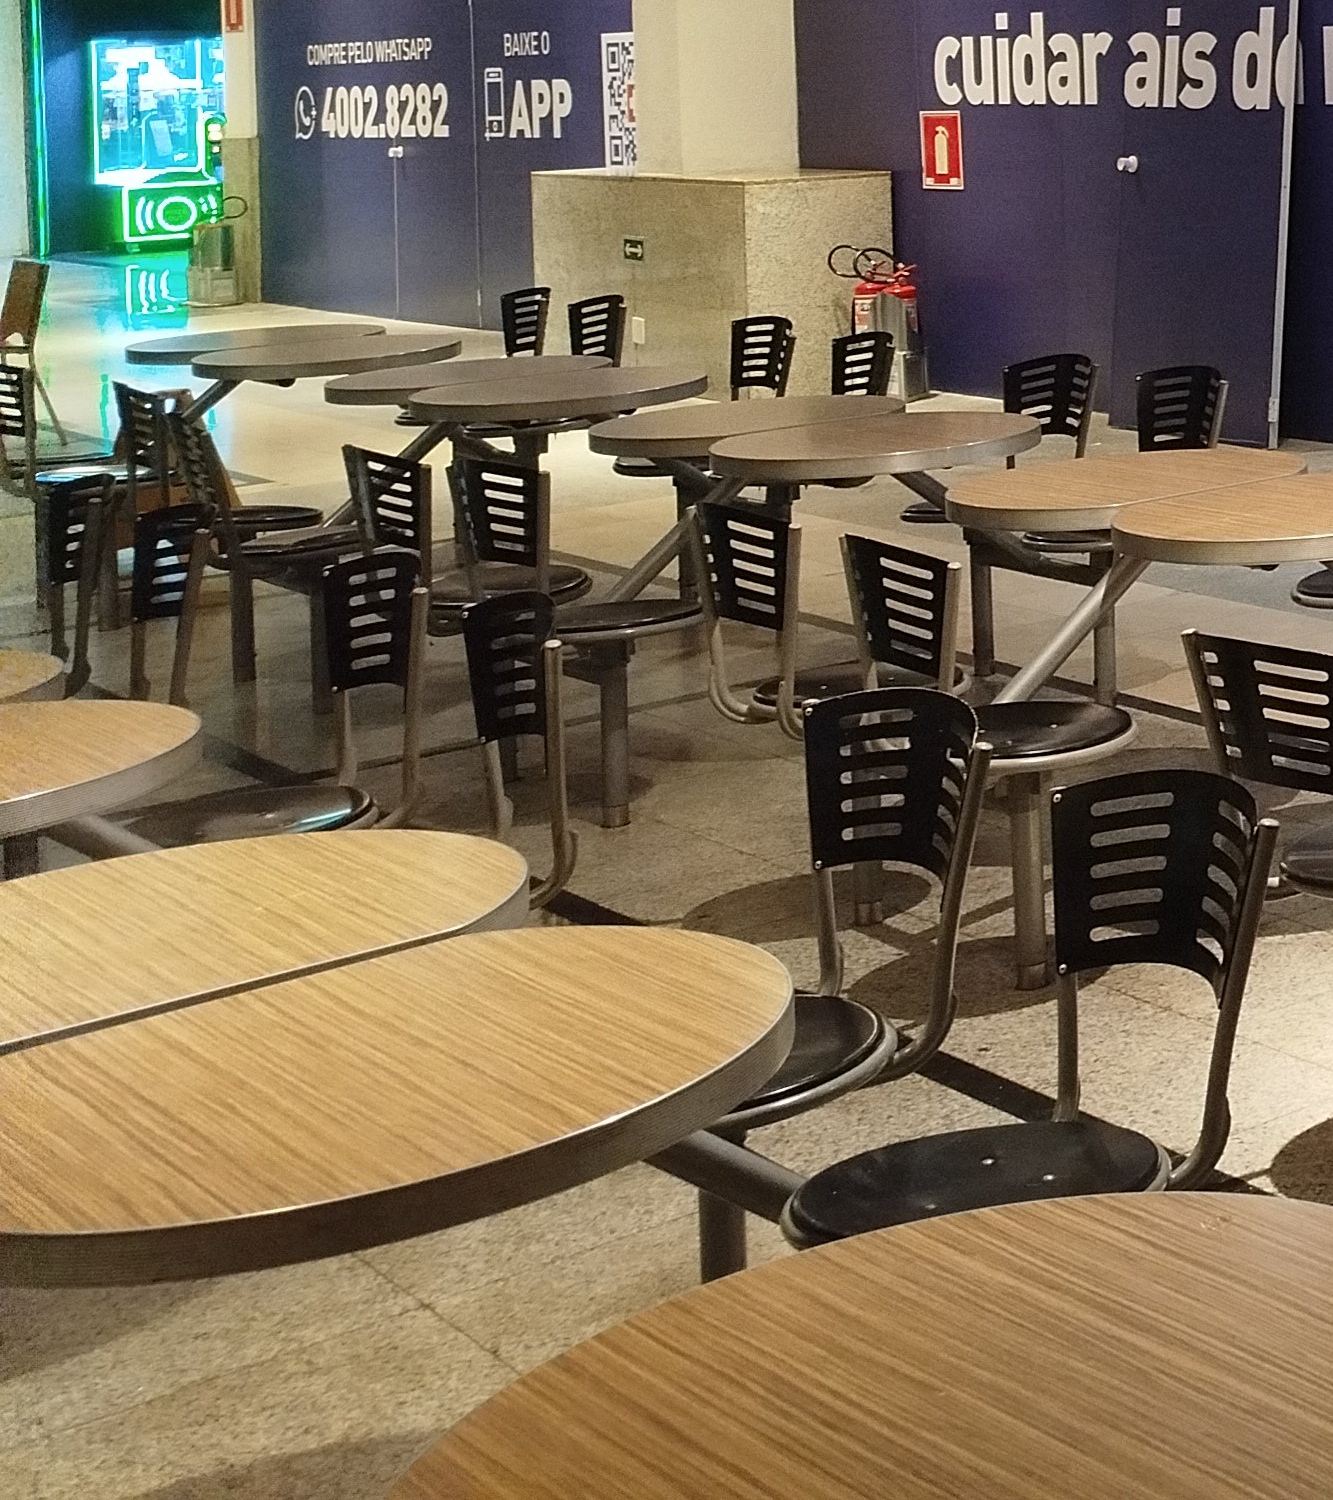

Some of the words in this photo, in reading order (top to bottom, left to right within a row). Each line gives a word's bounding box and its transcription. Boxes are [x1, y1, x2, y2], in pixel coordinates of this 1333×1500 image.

[307, 42, 347, 66] COMPRE
[348, 41, 374, 64] PELO
[374, 37, 433, 63] WHATSAPP
[503, 33, 537, 57] BAIXE
[934, 12, 1113, 107] cuidar
[1124, 7, 1217, 110] ais
[321, 83, 450, 140] 4002.8282
[509, 78, 573, 139] APP
